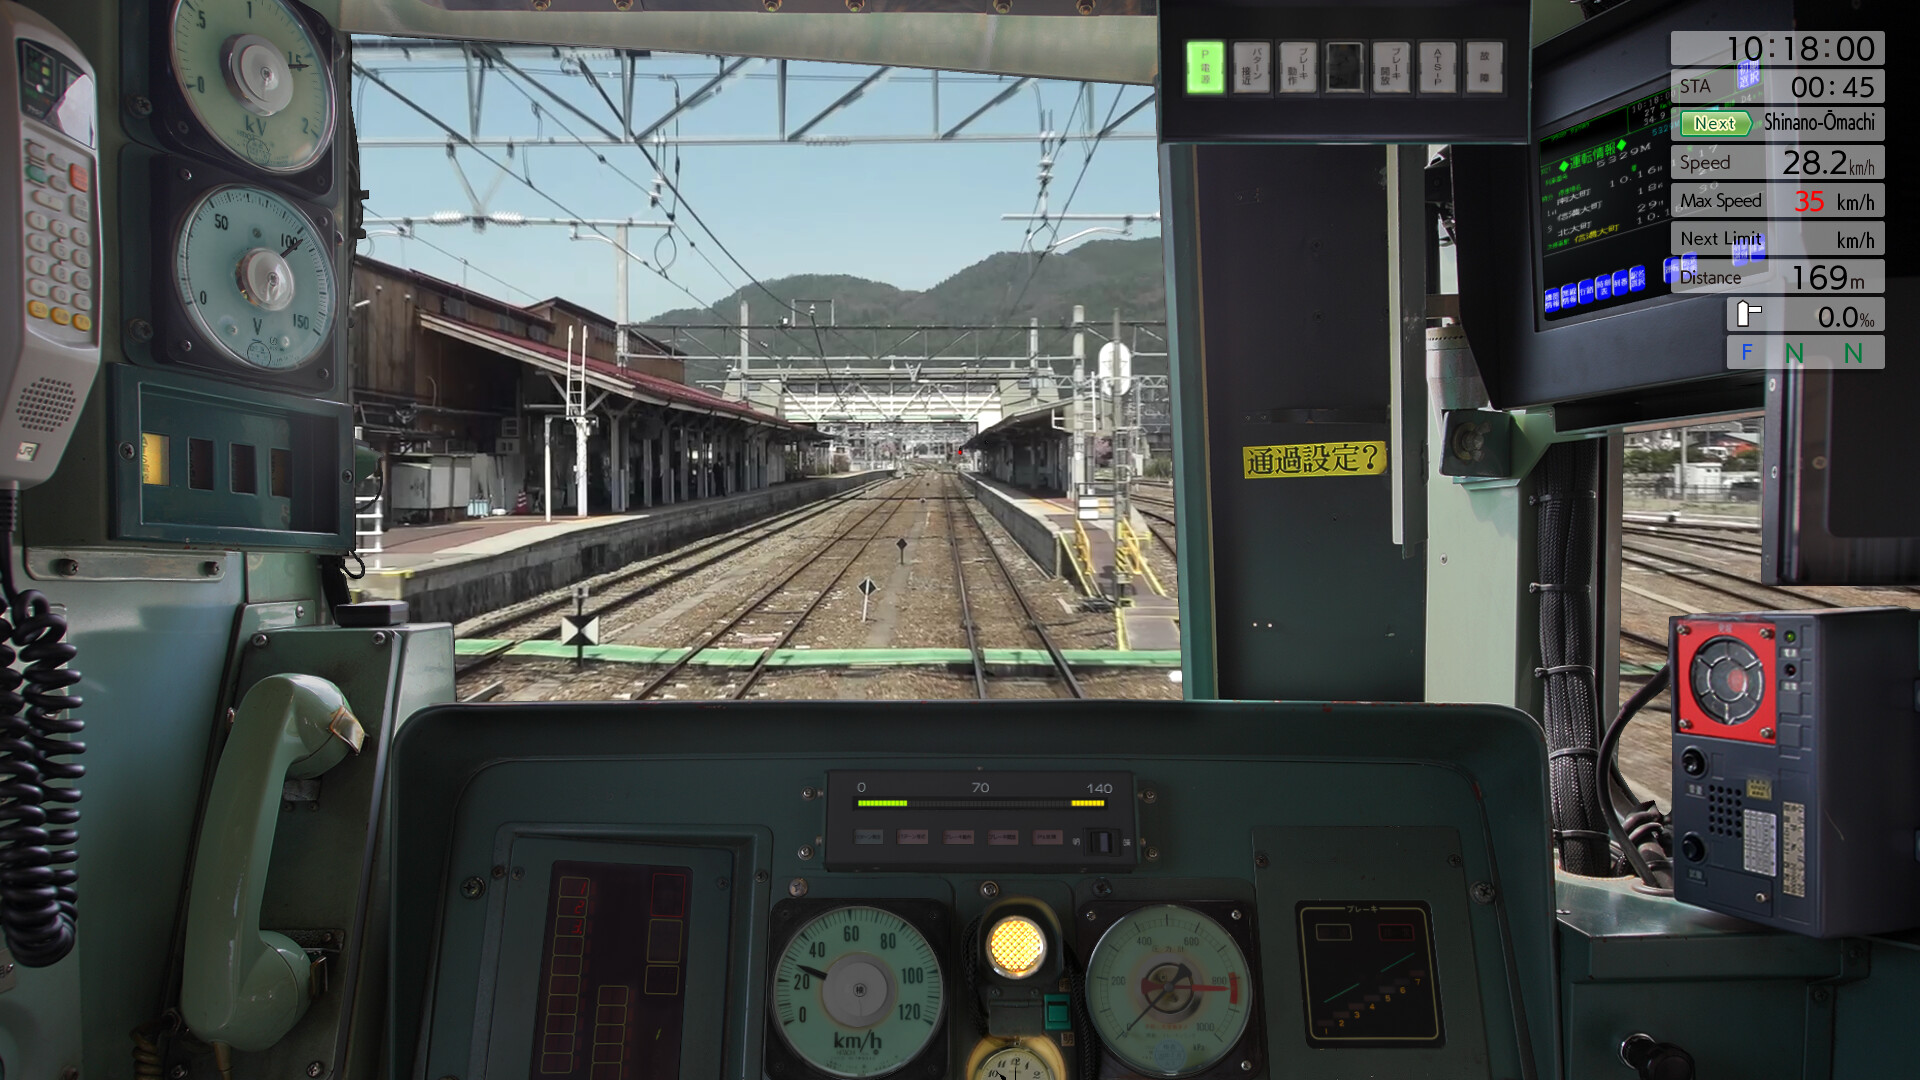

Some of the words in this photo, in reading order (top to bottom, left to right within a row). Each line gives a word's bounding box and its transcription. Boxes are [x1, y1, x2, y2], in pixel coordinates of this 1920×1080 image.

[1252, 48, 1263, 80] パターン
[1299, 48, 1308, 80] ブレーキ
[1391, 47, 1401, 80] ブレーキ
[1433, 48, 1443, 86] ATS-P
[197, 76, 205, 93] 0
[1241, 66, 1252, 85] 接近
[1287, 66, 1298, 85] 動作
[1380, 66, 1391, 85] 開放
[245, 116, 267, 136] kV
[1569, 141, 1616, 171] 運転情報
[1596, 143, 1652, 169] 5329M
[214, 213, 229, 231] 50
[281, 233, 298, 251] 100
[200, 290, 207, 305] 0
[252, 317, 263, 335] V
[293, 313, 310, 330] 150
[1248, 443, 1378, 475] 通過設定？
[857, 782, 866, 793] 0
[971, 782, 990, 793] 70
[1086, 783, 1113, 794] 140
[1346, 905, 1378, 913] ブレーキ
[843, 925, 859, 942] 60
[880, 932, 896, 949] 80
[1136, 937, 1152, 946] 400
[1184, 937, 1200, 946] 600
[809, 941, 825, 958] 40
[794, 973, 810, 990] 20
[902, 967, 923, 984] 100
[1111, 976, 1126, 986] 200
[799, 1006, 806, 1023] 0
[899, 1003, 921, 1021] 120
[1196, 1023, 1215, 1031] 1000
[834, 1029, 882, 1052] km/h
